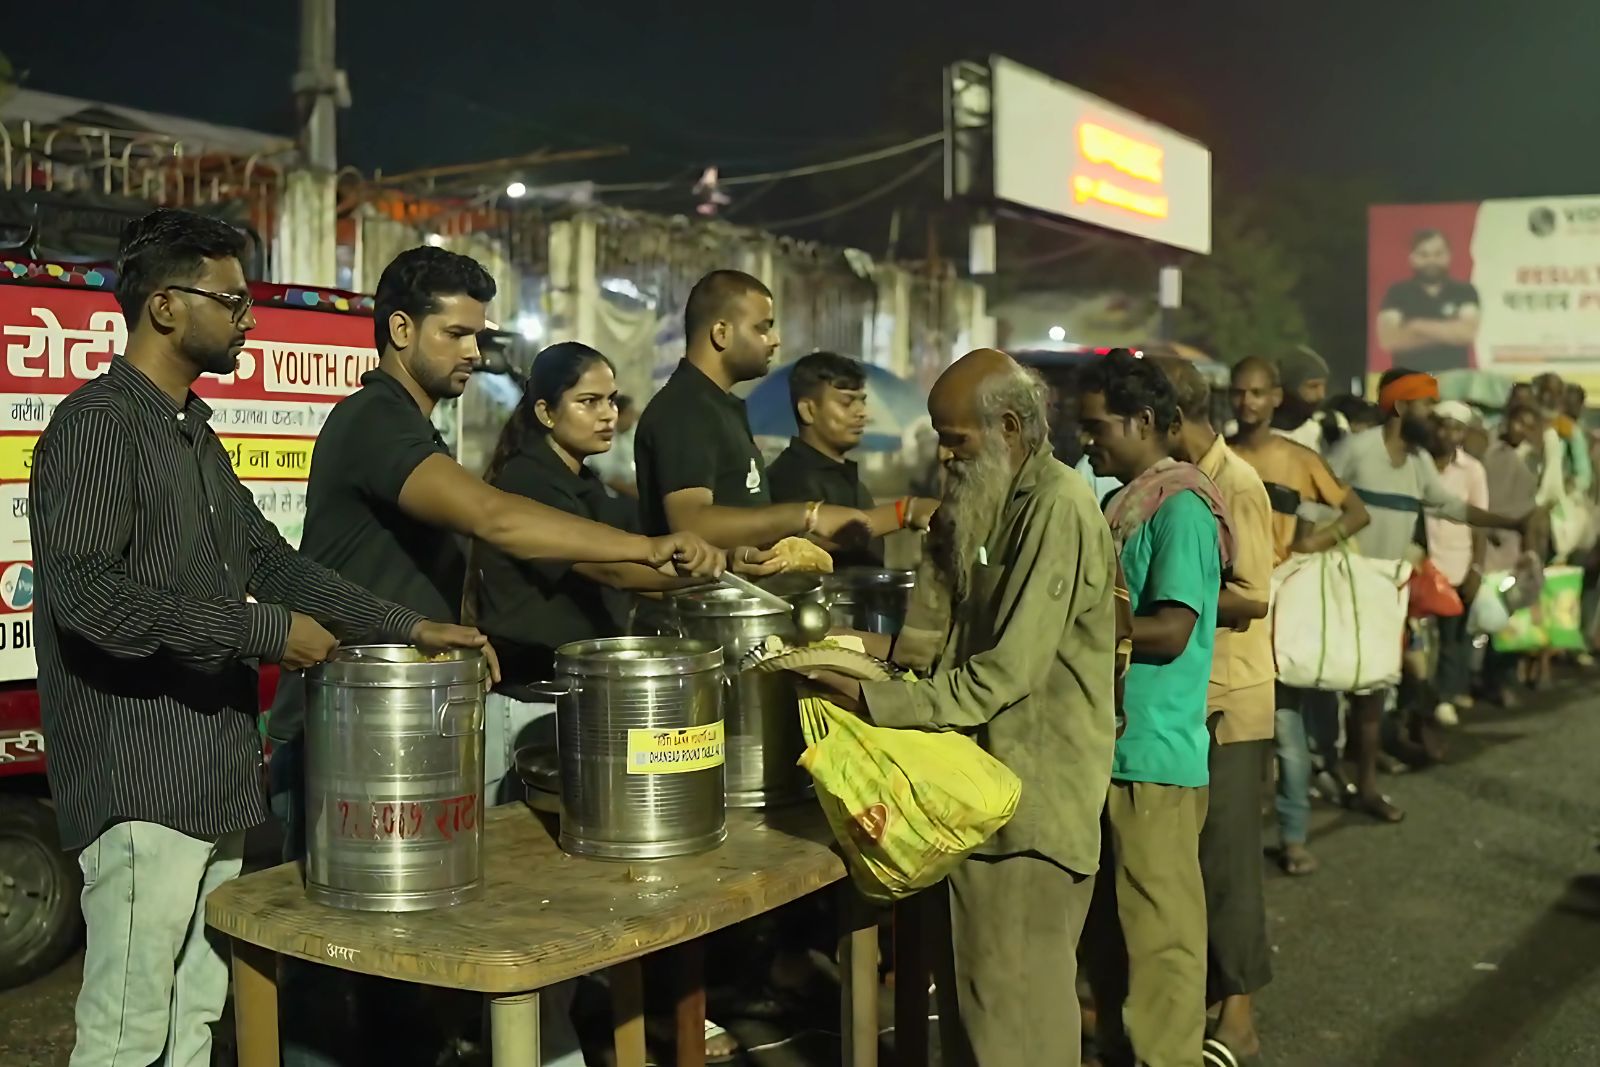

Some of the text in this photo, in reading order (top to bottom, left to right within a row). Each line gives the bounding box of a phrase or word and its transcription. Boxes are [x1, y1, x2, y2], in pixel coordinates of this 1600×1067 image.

[3, 307, 128, 379] रोटी
[272, 350, 337, 387] YOUTH
[344, 354, 380, 387] CL
